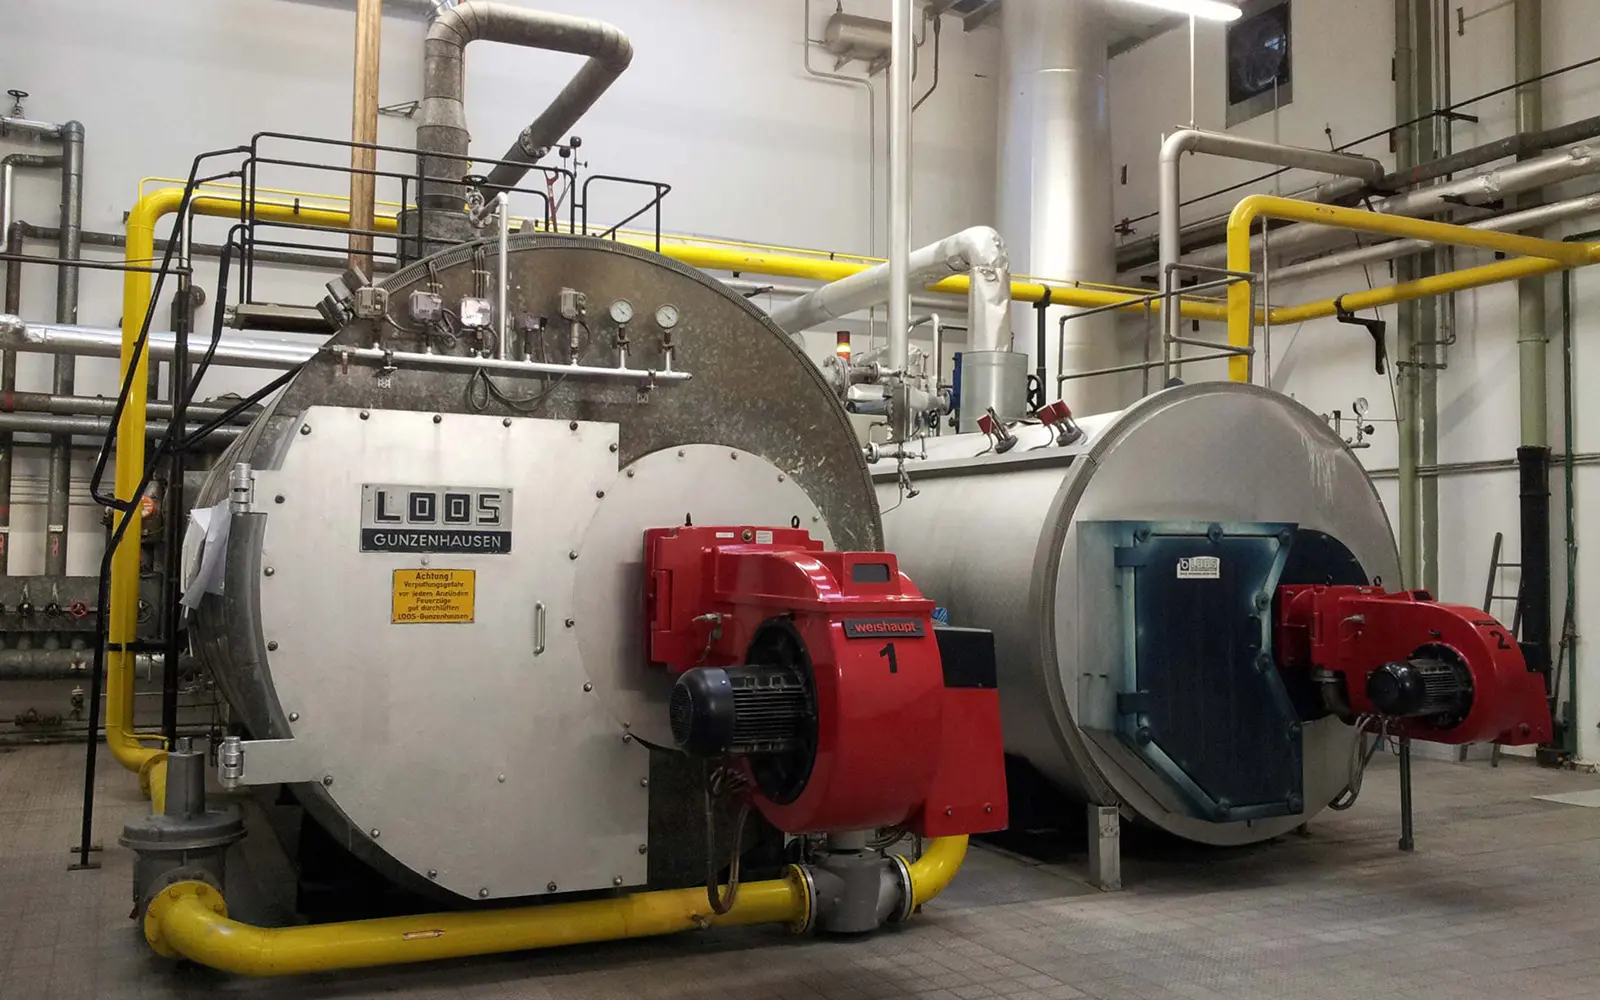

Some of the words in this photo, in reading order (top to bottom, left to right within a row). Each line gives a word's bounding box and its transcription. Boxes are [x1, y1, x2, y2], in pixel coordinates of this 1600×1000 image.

[375, 489, 502, 526] LOOS
[373, 533, 501, 548] GUNZENHAUSEN
[411, 590, 433, 598] jedem
[416, 597, 452, 605] Feuerzüge
[407, 604, 419, 612] gut
[420, 604, 460, 612] durchlüften
[854, 621, 917, 633] weishaupt
[1490, 630, 1511, 650] 2
[879, 642, 898, 674] 1
